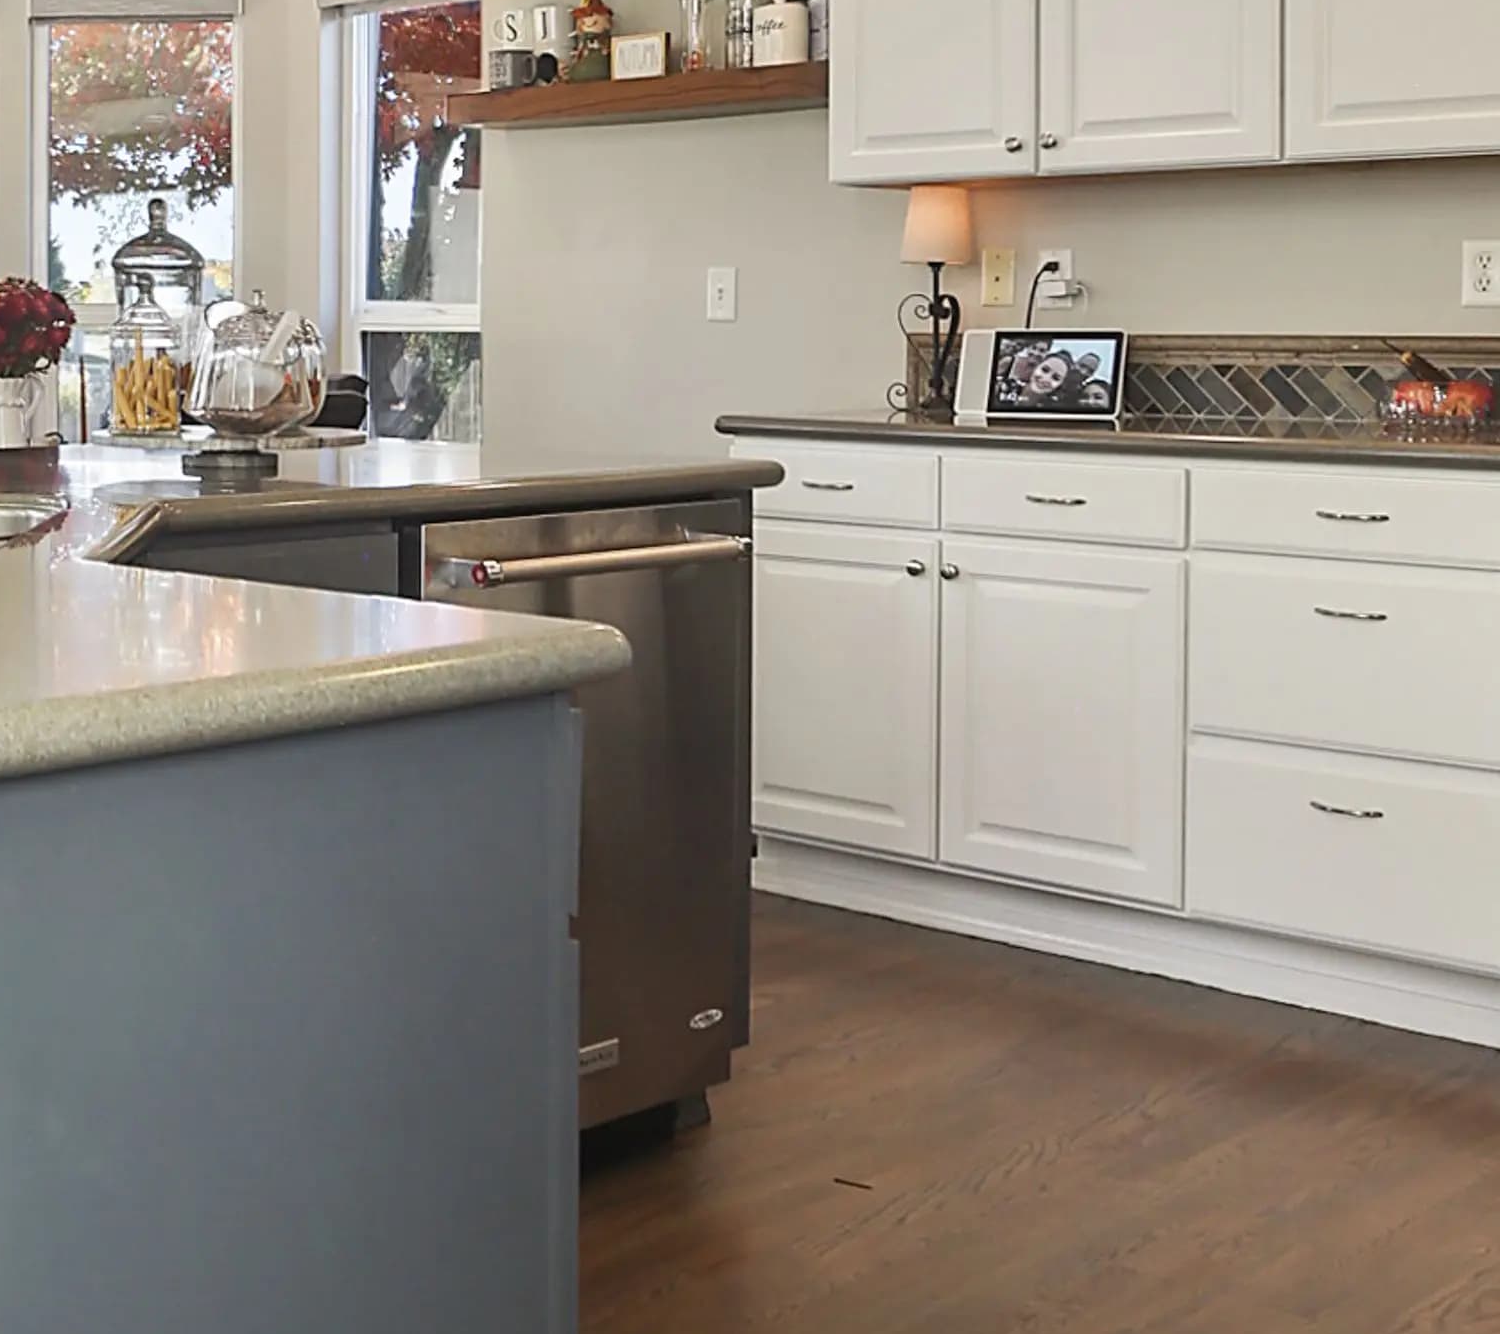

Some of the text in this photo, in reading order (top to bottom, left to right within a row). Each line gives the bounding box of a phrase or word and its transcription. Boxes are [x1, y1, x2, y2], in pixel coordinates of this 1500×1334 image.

[505, 13, 518, 43] S
[541, 11, 548, 40] J
[755, 18, 787, 36] offee
